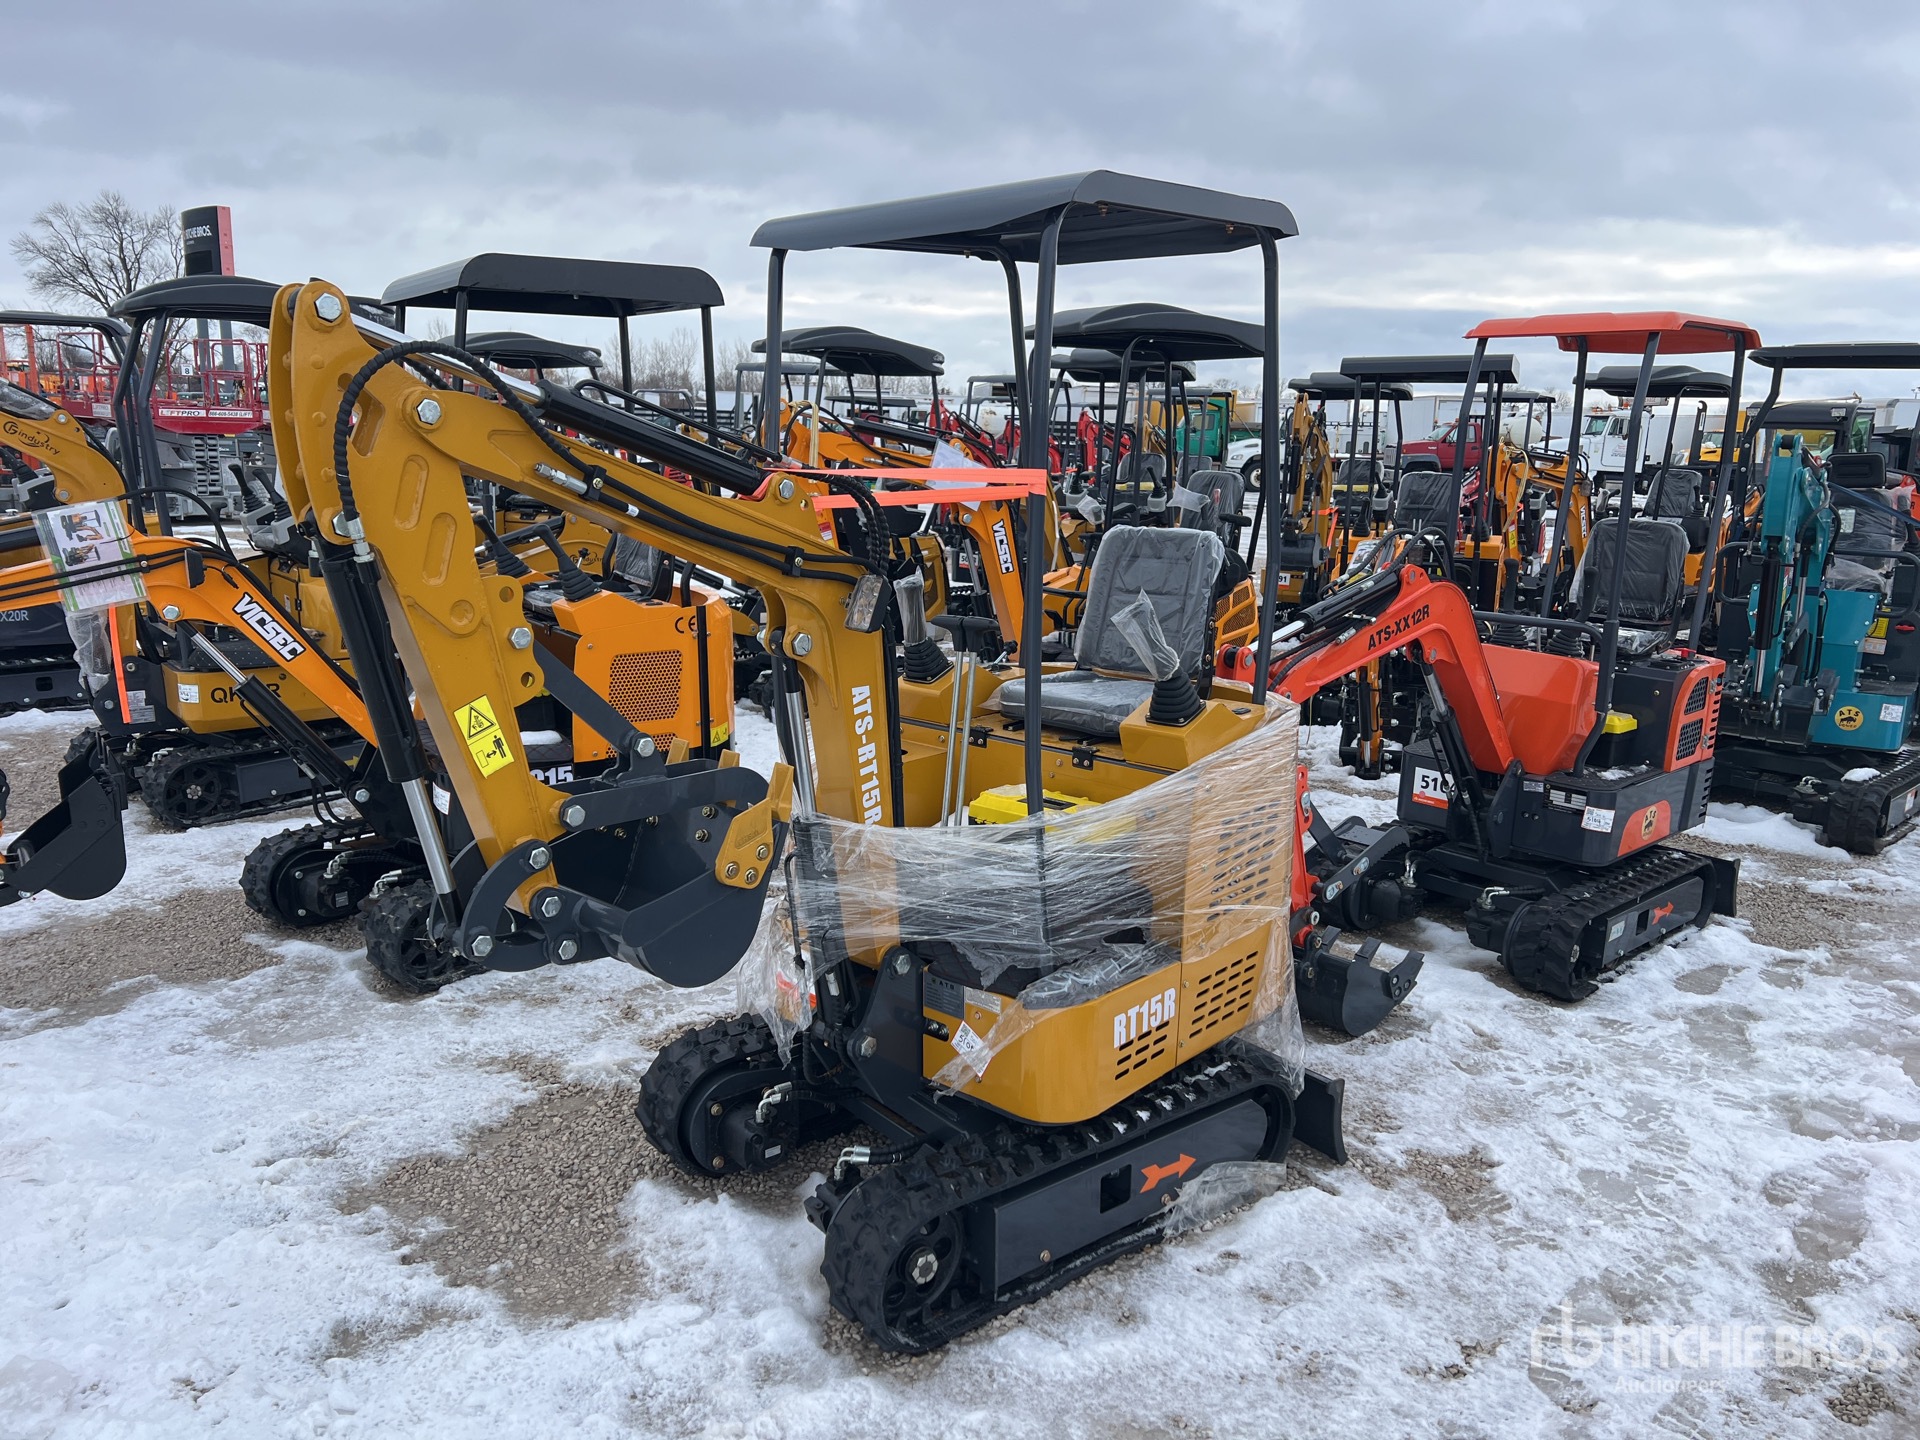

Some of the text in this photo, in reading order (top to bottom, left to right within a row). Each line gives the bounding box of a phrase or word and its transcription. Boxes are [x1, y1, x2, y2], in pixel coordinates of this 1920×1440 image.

[18, 431, 61, 455] industry
[993, 519, 1014, 574] VICSEC
[233, 592, 306, 661] VICSEC
[1839, 709, 1860, 717] ATS
[1645, 810, 1657, 823] ATS
[1113, 988, 1176, 1048] RT15R
